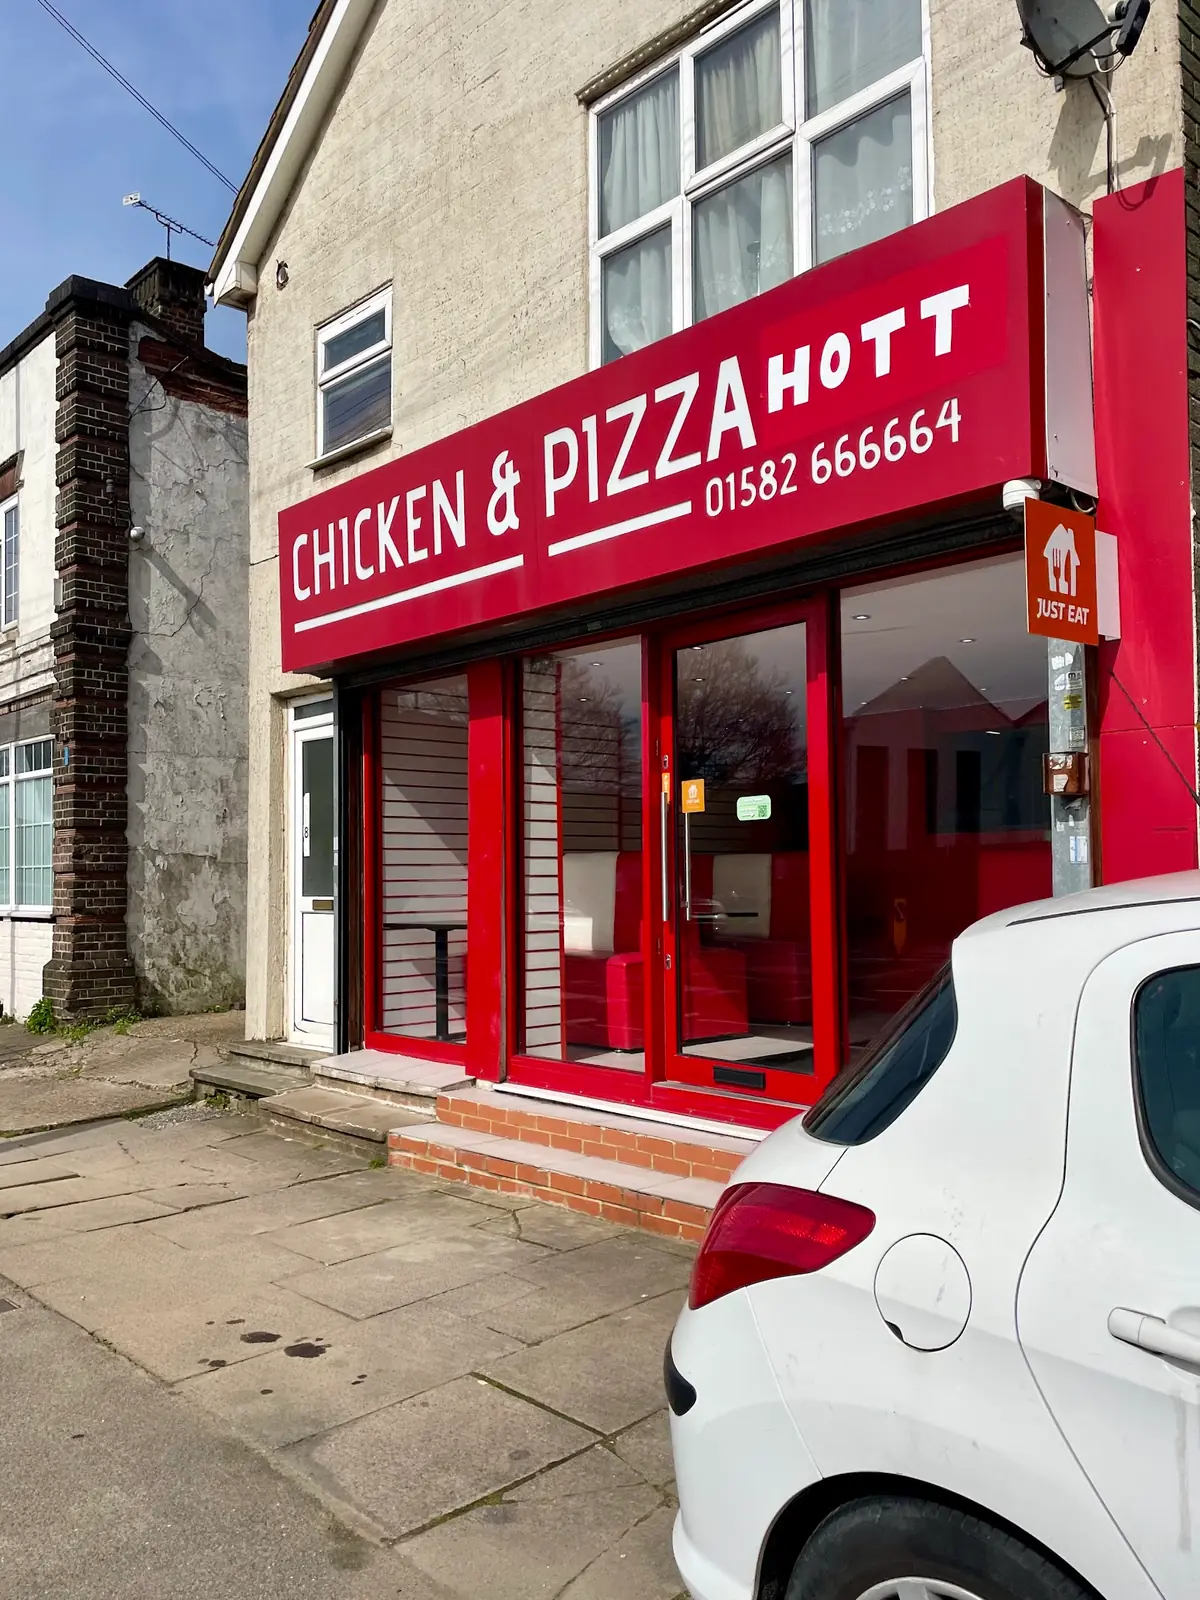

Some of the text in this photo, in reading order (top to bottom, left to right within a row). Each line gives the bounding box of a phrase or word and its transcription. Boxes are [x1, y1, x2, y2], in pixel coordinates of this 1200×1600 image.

[292, 283, 970, 602] CHICKEN & PIZZA HOTT
[705, 397, 962, 517] 01582 666664
[1036, 597, 1090, 625] JUST EAT
